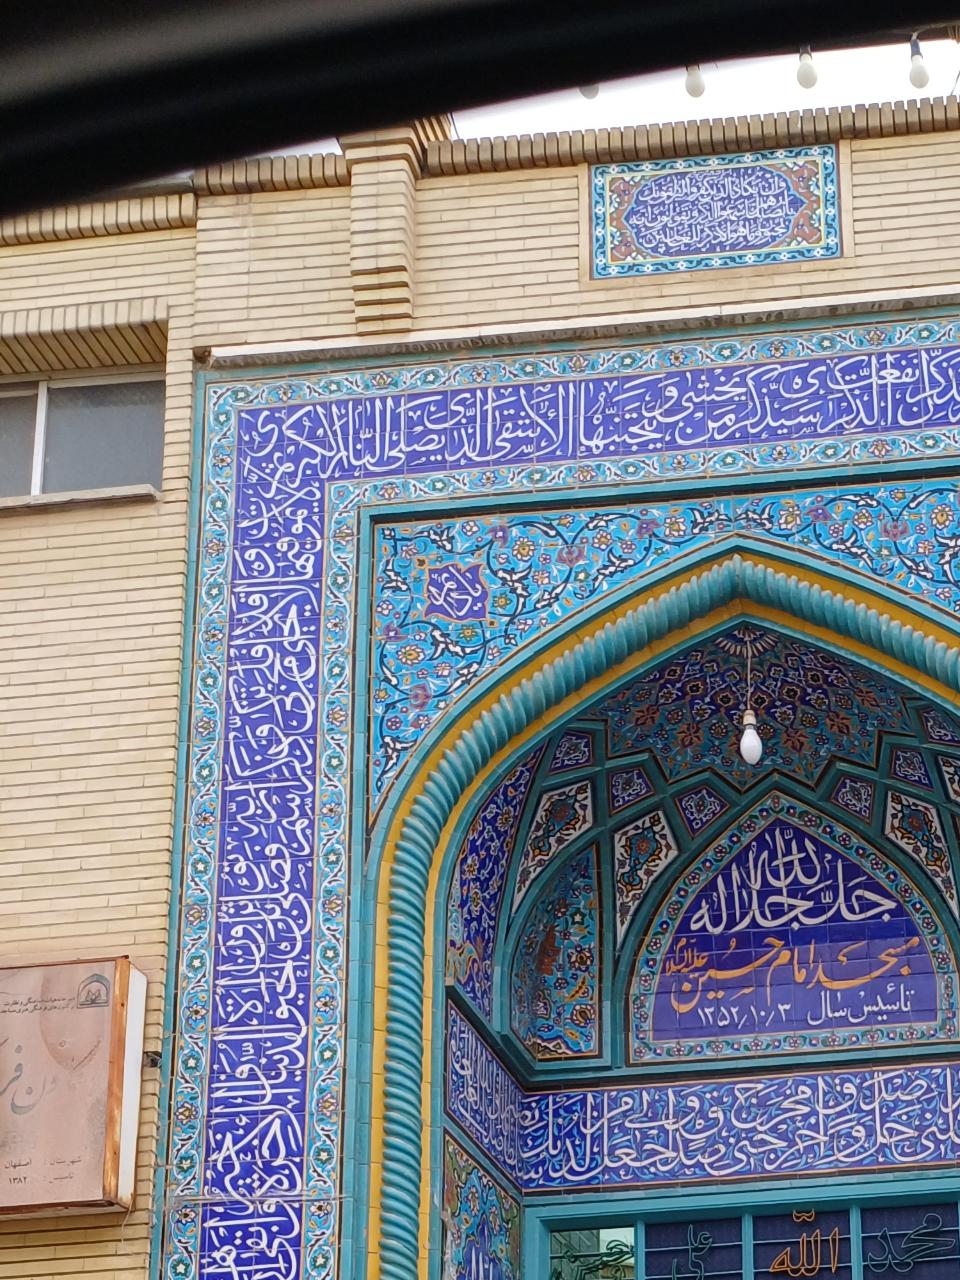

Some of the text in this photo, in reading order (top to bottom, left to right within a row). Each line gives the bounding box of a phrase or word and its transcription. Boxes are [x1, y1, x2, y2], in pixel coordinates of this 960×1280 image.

[671, 936, 785, 1013] حسین
[767, 939, 815, 1007] امام
[806, 936, 919, 990] مسجد
[807, 989, 847, 1026] سال
[768, 1209, 840, 1277] الله
[867, 1213, 957, 1273] محمد
